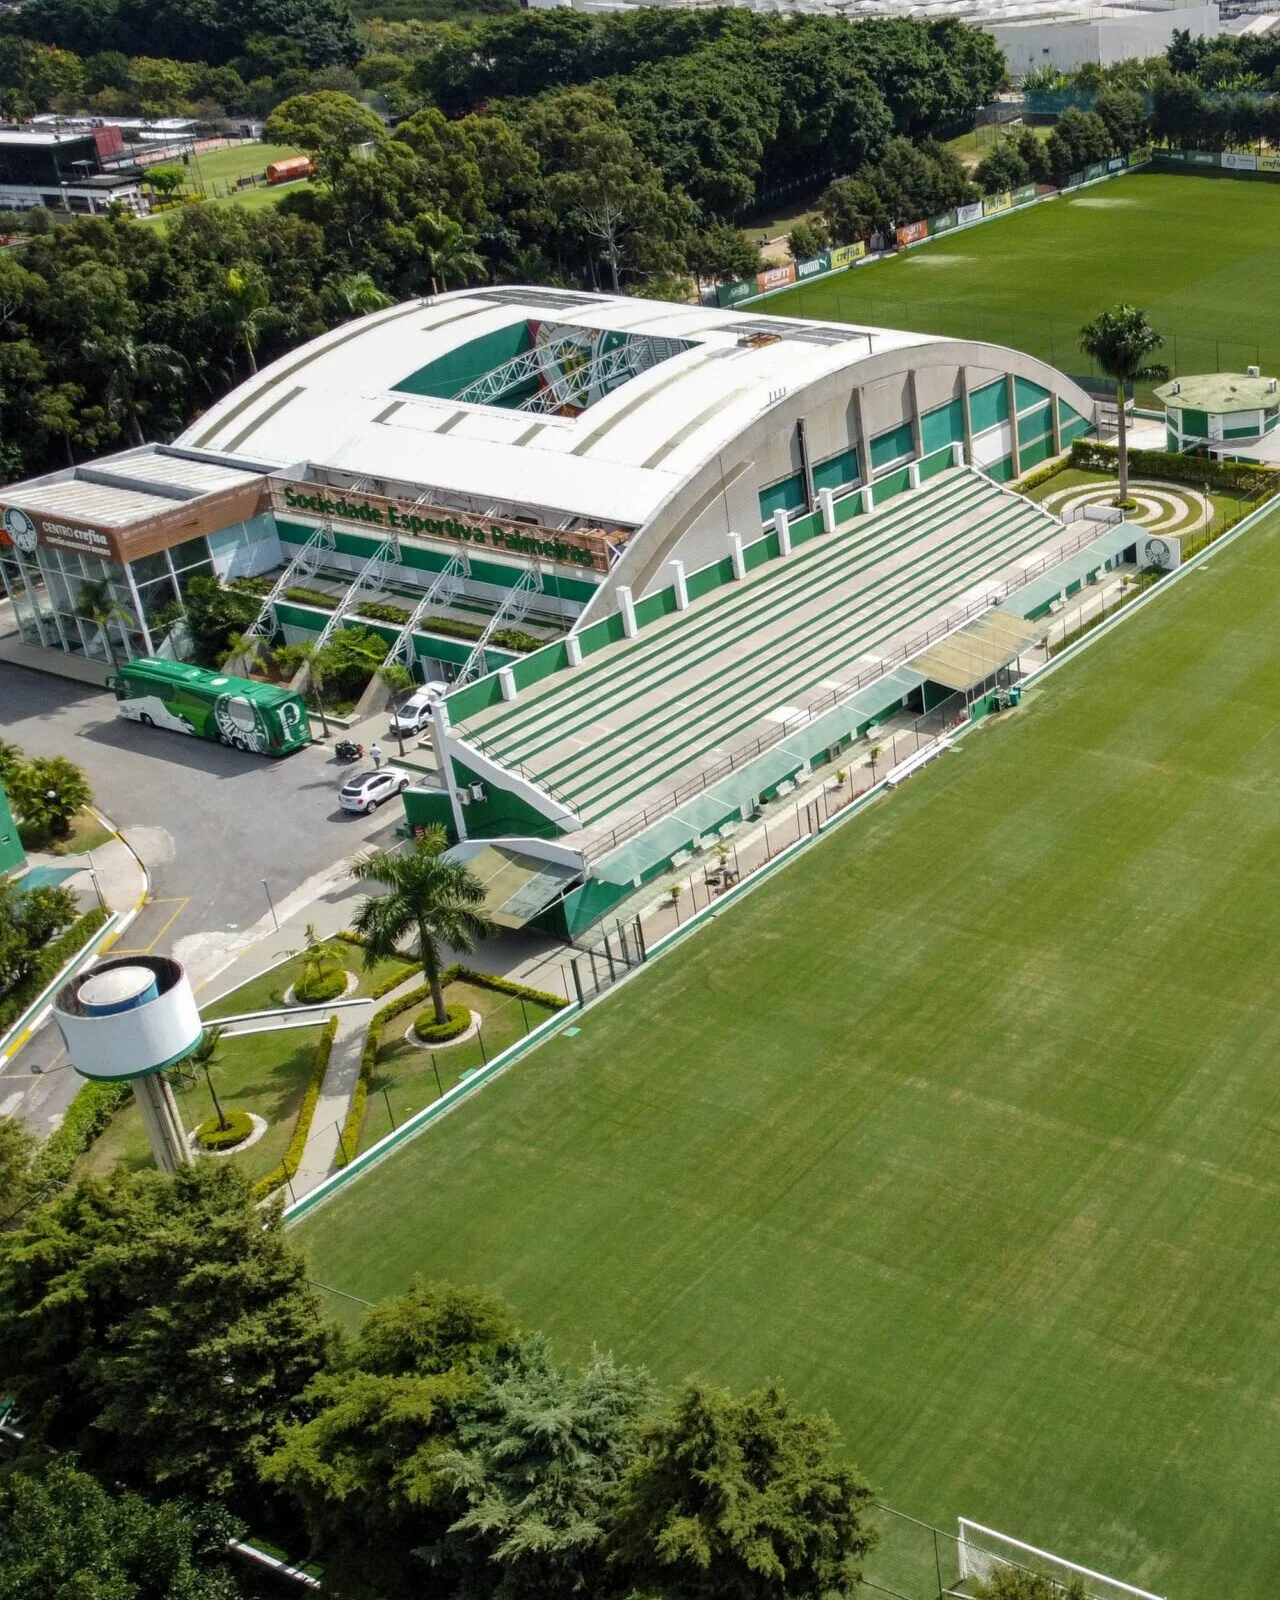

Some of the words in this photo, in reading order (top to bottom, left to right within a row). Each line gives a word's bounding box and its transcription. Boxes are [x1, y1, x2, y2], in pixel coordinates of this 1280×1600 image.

[42, 521, 74, 539] CENTRO
[74, 529, 108, 545] crefisa
[285, 486, 383, 524] Sociedade
[388, 506, 486, 544] Esportiva
[490, 525, 594, 566] Palmeiras
